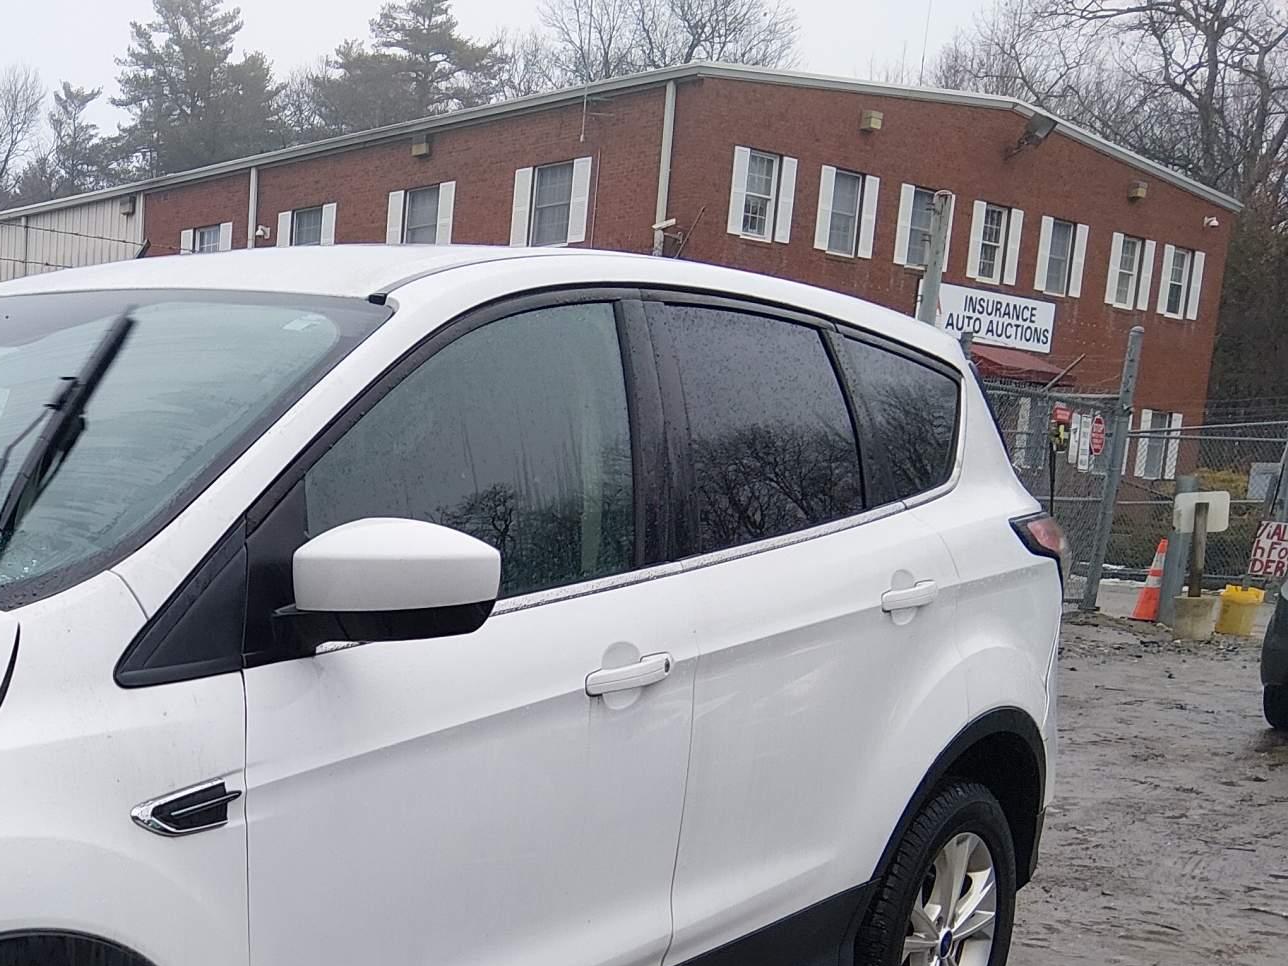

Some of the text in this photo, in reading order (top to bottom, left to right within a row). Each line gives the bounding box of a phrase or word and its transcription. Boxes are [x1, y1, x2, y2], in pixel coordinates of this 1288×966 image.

[964, 295, 1037, 323] INSURANCE
[945, 313, 1049, 345] AUTO AUCTIONS
